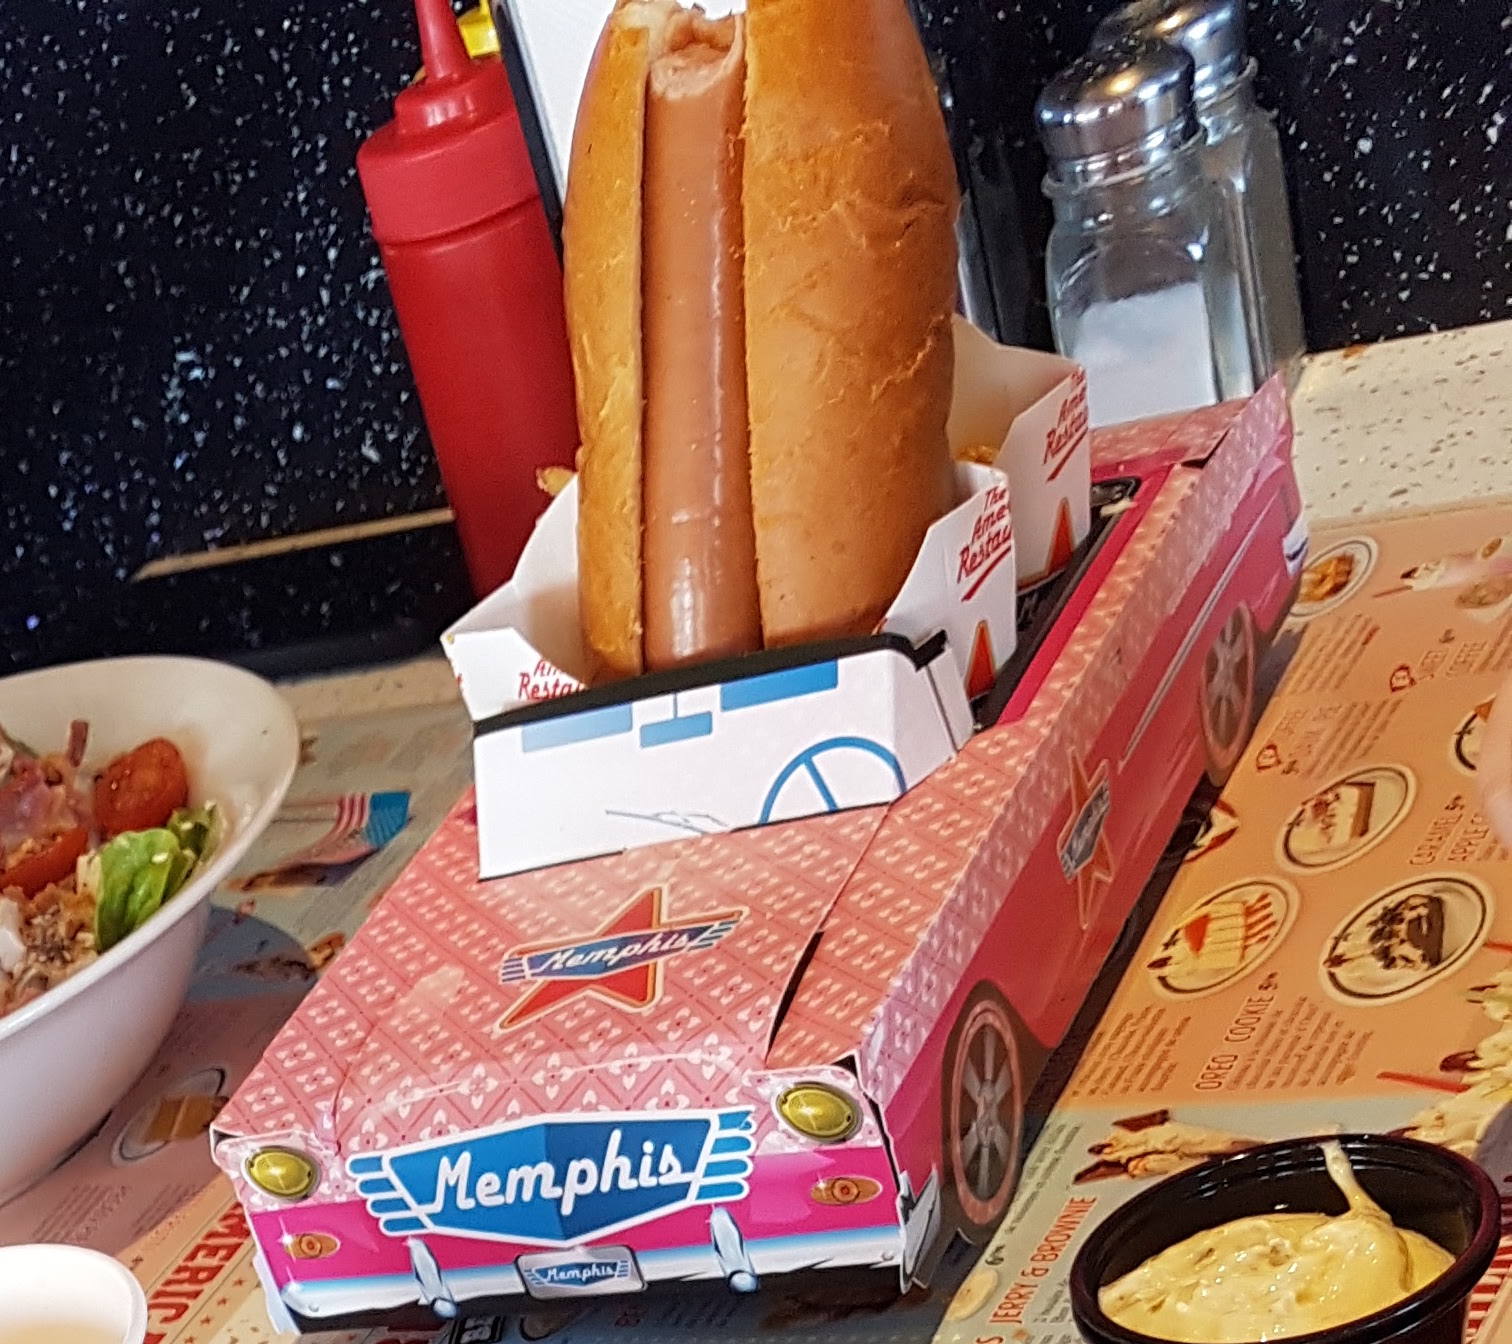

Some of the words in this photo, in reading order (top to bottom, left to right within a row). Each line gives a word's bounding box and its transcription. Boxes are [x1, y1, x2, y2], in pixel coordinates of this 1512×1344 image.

[541, 930, 694, 972] Memphis
[422, 1128, 700, 1217] Memphis
[541, 1262, 619, 1283] Memphis
[988, 1281, 1038, 1327] JERRY
[1029, 1194, 1096, 1264] BROWNIE
